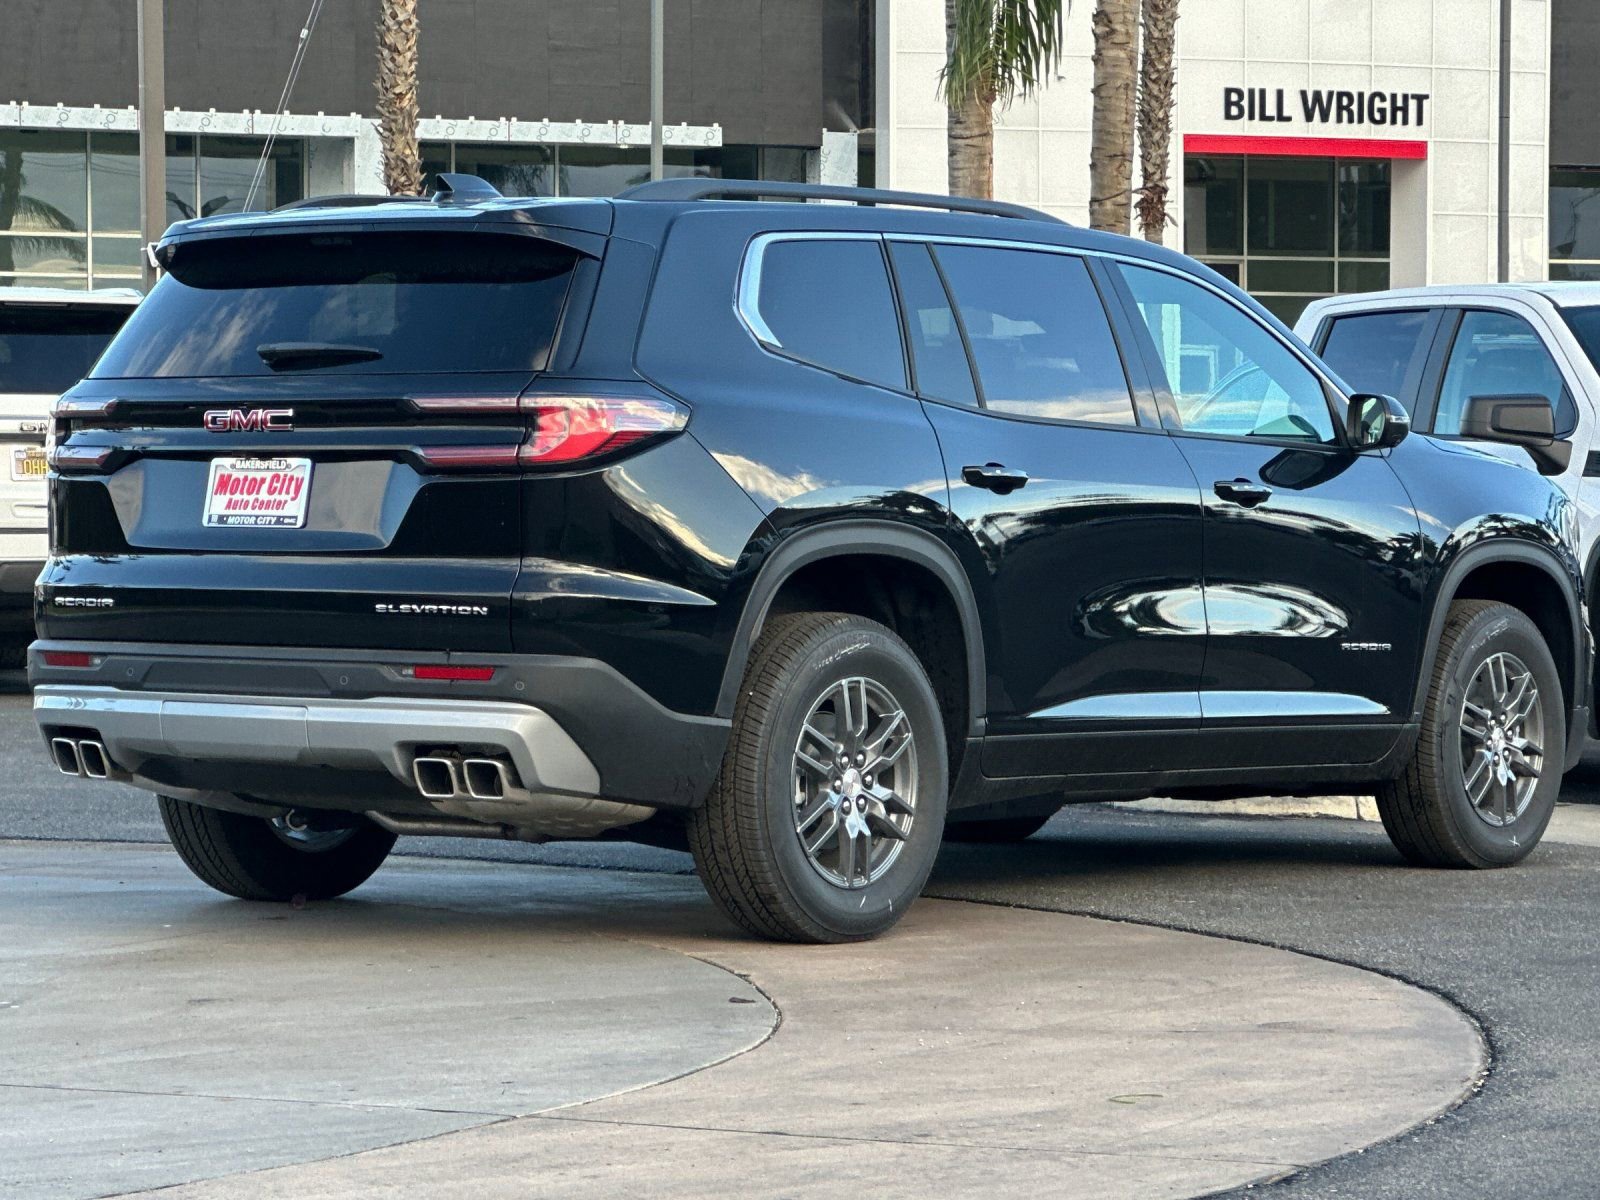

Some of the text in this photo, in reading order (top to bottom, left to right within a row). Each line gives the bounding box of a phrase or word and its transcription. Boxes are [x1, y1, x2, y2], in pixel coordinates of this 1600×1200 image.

[1223, 87, 1430, 126] BILL WRIGHT
[204, 408, 294, 431] GMC
[235, 459, 287, 470] BAKERSFIELD
[214, 473, 304, 501] Motor City
[225, 498, 288, 510] Auto Center
[227, 516, 256, 525] MOTOR
[257, 517, 276, 525] CITY
[54, 597, 114, 607] ACADIA
[375, 604, 488, 615] ELEVATION
[1341, 643, 1392, 651] ACADIA
